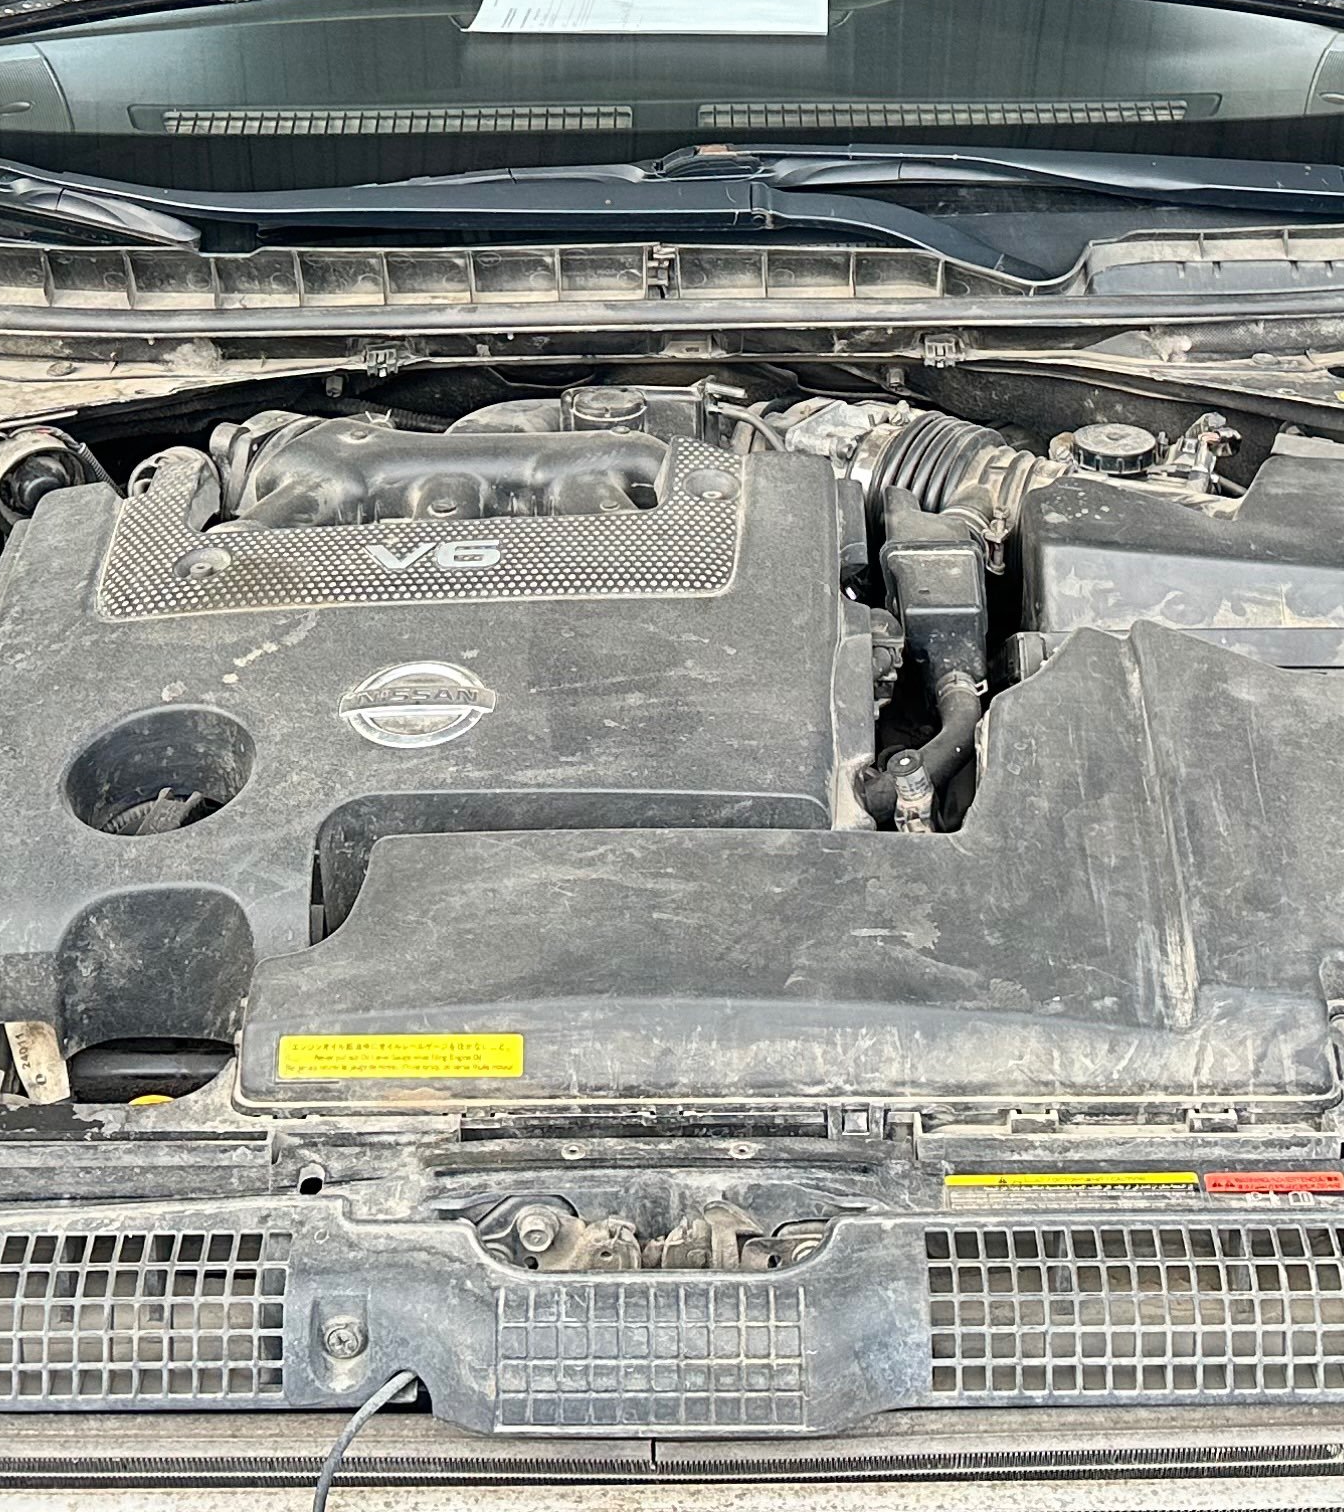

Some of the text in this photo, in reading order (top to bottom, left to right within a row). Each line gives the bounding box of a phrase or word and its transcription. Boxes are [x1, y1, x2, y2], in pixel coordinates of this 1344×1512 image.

[364, 539, 501, 572] V6
[357, 686, 480, 705] NISSAN
[15, 1033, 31, 1070] 24011
